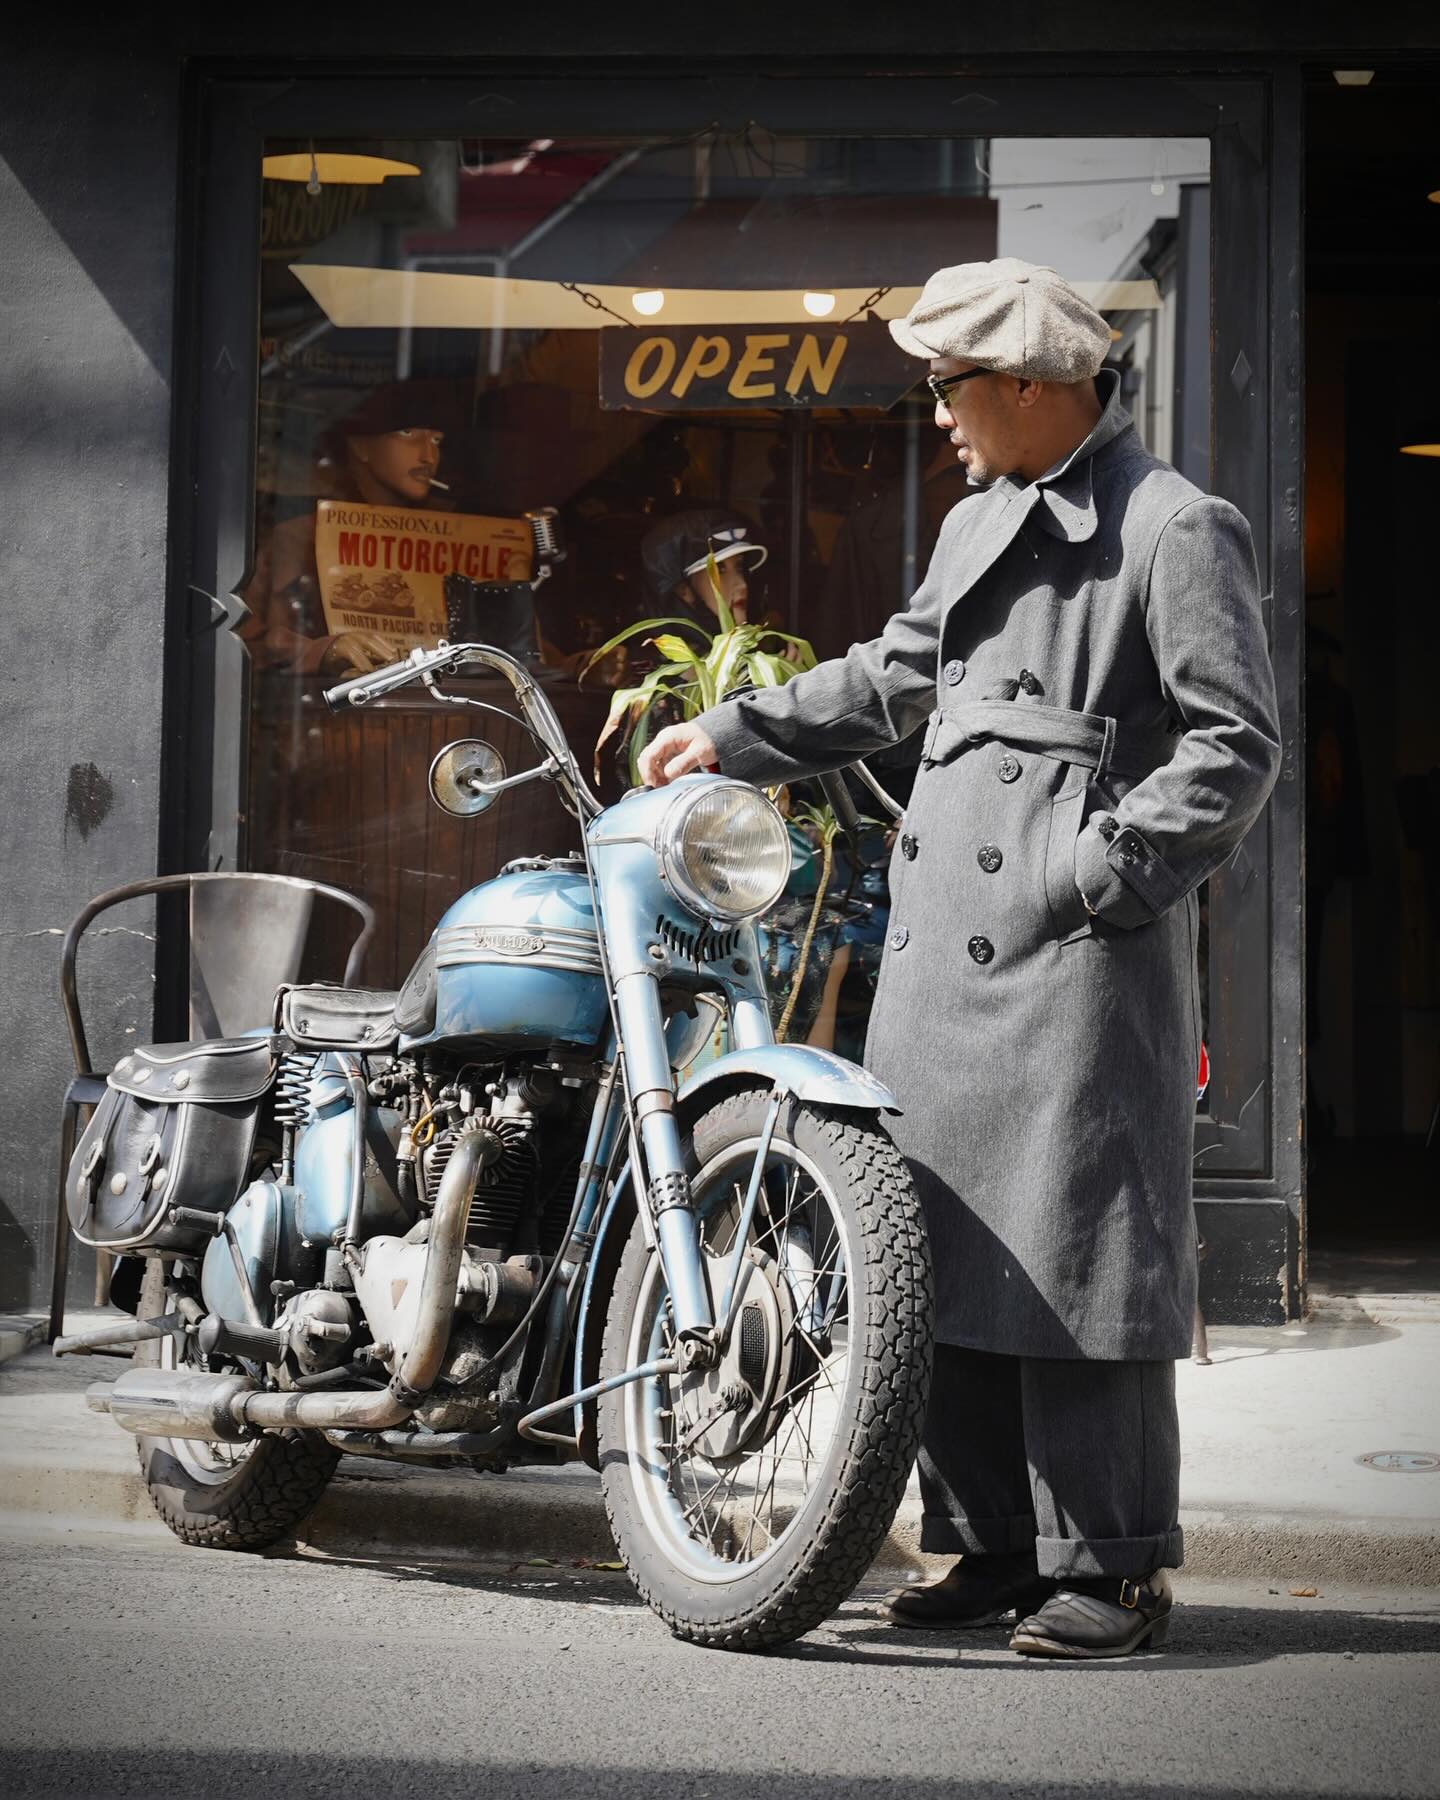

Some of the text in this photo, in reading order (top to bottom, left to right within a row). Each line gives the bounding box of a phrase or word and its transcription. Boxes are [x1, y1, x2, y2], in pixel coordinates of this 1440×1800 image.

[624, 333, 848, 400] OPEN
[326, 508, 453, 536] PROFESSIONAL
[338, 531, 513, 580] MOTORCYCLE
[343, 613, 378, 630] NORTH
[383, 618, 425, 635] PACIFIC
